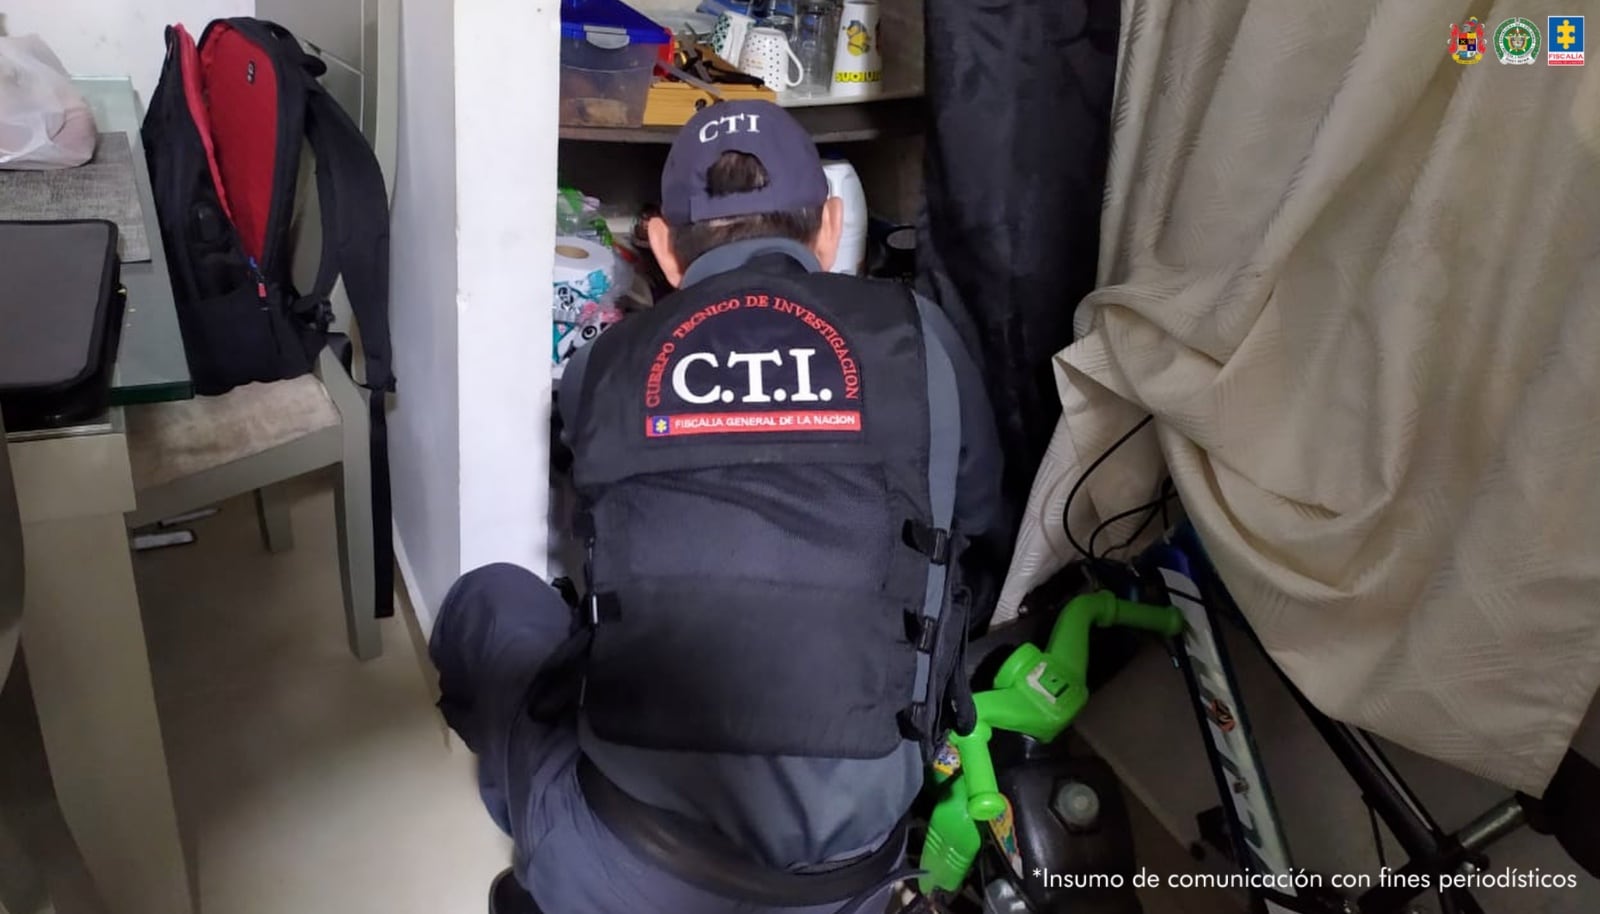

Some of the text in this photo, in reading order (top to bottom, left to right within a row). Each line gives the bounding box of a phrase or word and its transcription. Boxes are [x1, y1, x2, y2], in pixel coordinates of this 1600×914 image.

[699, 113, 761, 144] CTI
[645, 296, 859, 408] CUERPO TECNICO DE INVESTIGACION
[672, 349, 832, 404] C.T.I.
[725, 416, 776, 426] GENERAL
[779, 416, 793, 425] DE
[797, 416, 811, 425] LA
